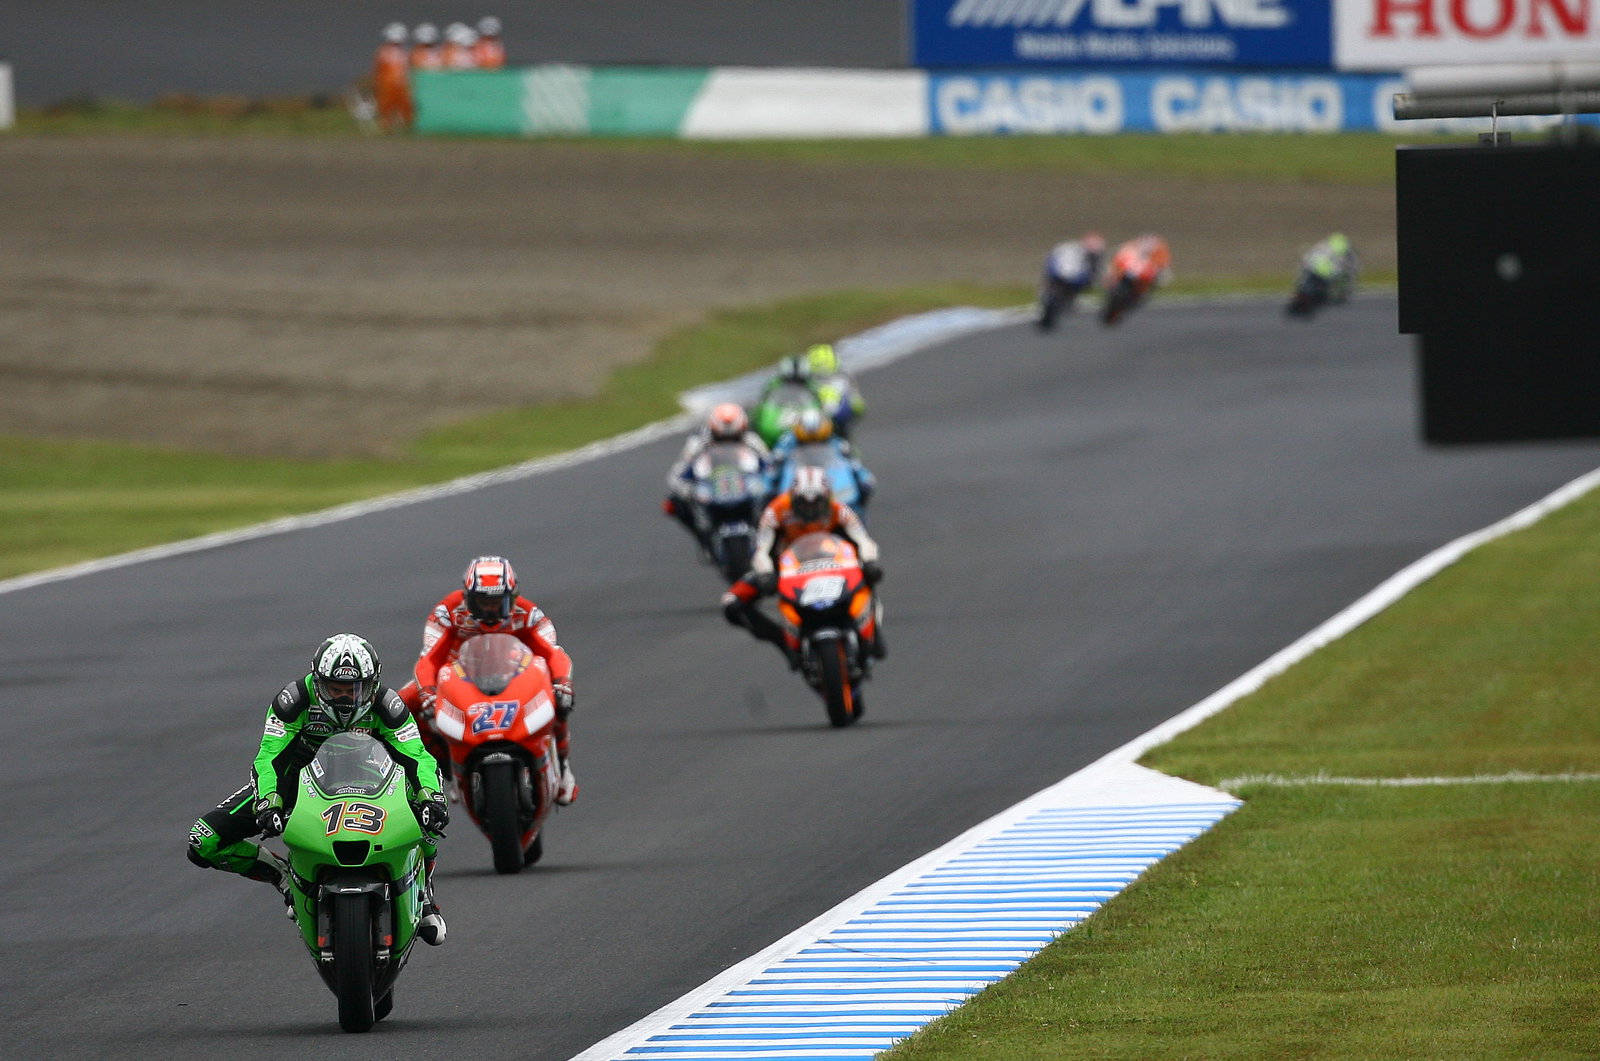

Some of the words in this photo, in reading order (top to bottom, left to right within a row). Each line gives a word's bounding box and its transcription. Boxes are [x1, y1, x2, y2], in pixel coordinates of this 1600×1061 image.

[937, 78, 1124, 133] CASIO
[1151, 78, 1343, 133] CASIO
[469, 701, 520, 736] 27
[320, 801, 388, 836] 13
